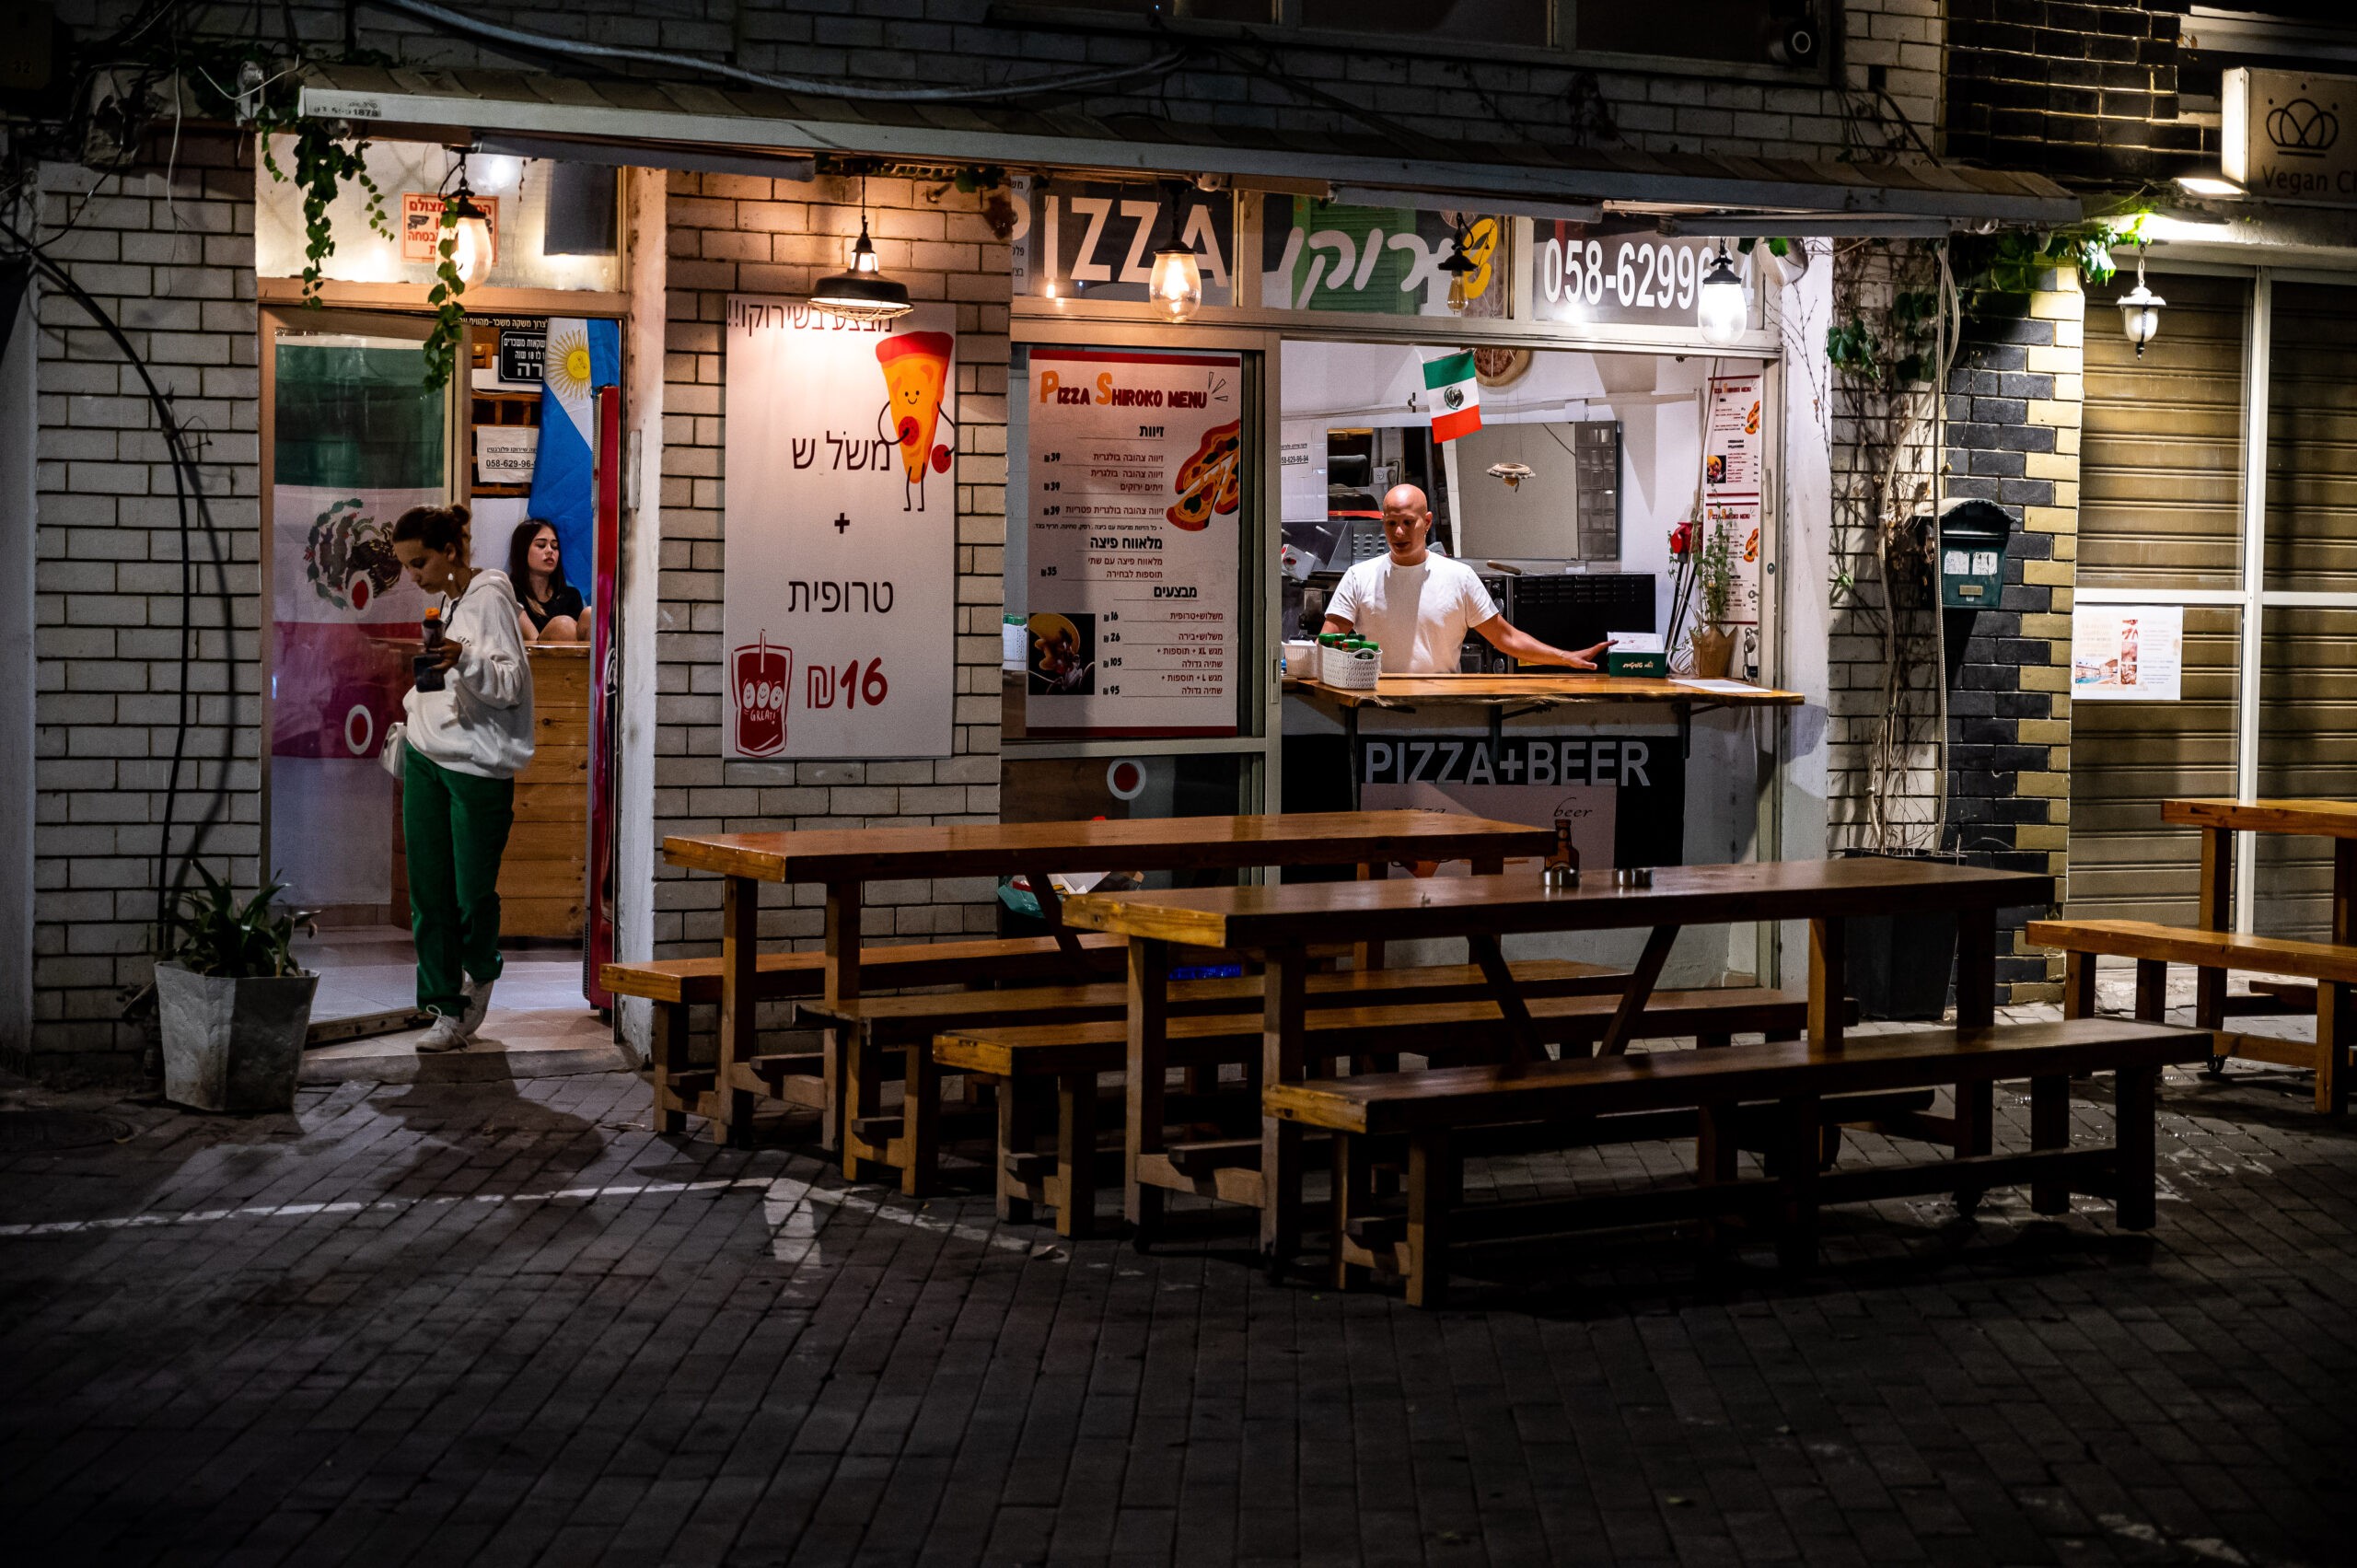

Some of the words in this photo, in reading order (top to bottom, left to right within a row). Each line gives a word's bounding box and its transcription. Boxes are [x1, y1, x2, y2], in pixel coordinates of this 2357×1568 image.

[2262, 166, 2328, 194] Vegan
[409, 198, 446, 212] מצולם
[408, 231, 438, 242] בטחה
[527, 339, 546, 350] שקאות
[1040, 370, 1090, 405] PIZZA
[1096, 372, 1163, 407] SHIROKO
[1167, 390, 1207, 409] MENU
[486, 459, 534, 468] 058-629-96-
[1090, 537, 1118, 549] פיצה
[1122, 536, 1162, 550] מלאווח
[1087, 557, 1102, 565] שתי
[1105, 557, 1115, 565] עם
[1117, 557, 1135, 565] פיצה
[1107, 570, 1133, 578] לבחירה
[788, 581, 894, 613] טרופית
[1154, 587, 1197, 598] מבצעים
[750, 709, 776, 726] GREAT!
[1553, 796, 1593, 818] beer
